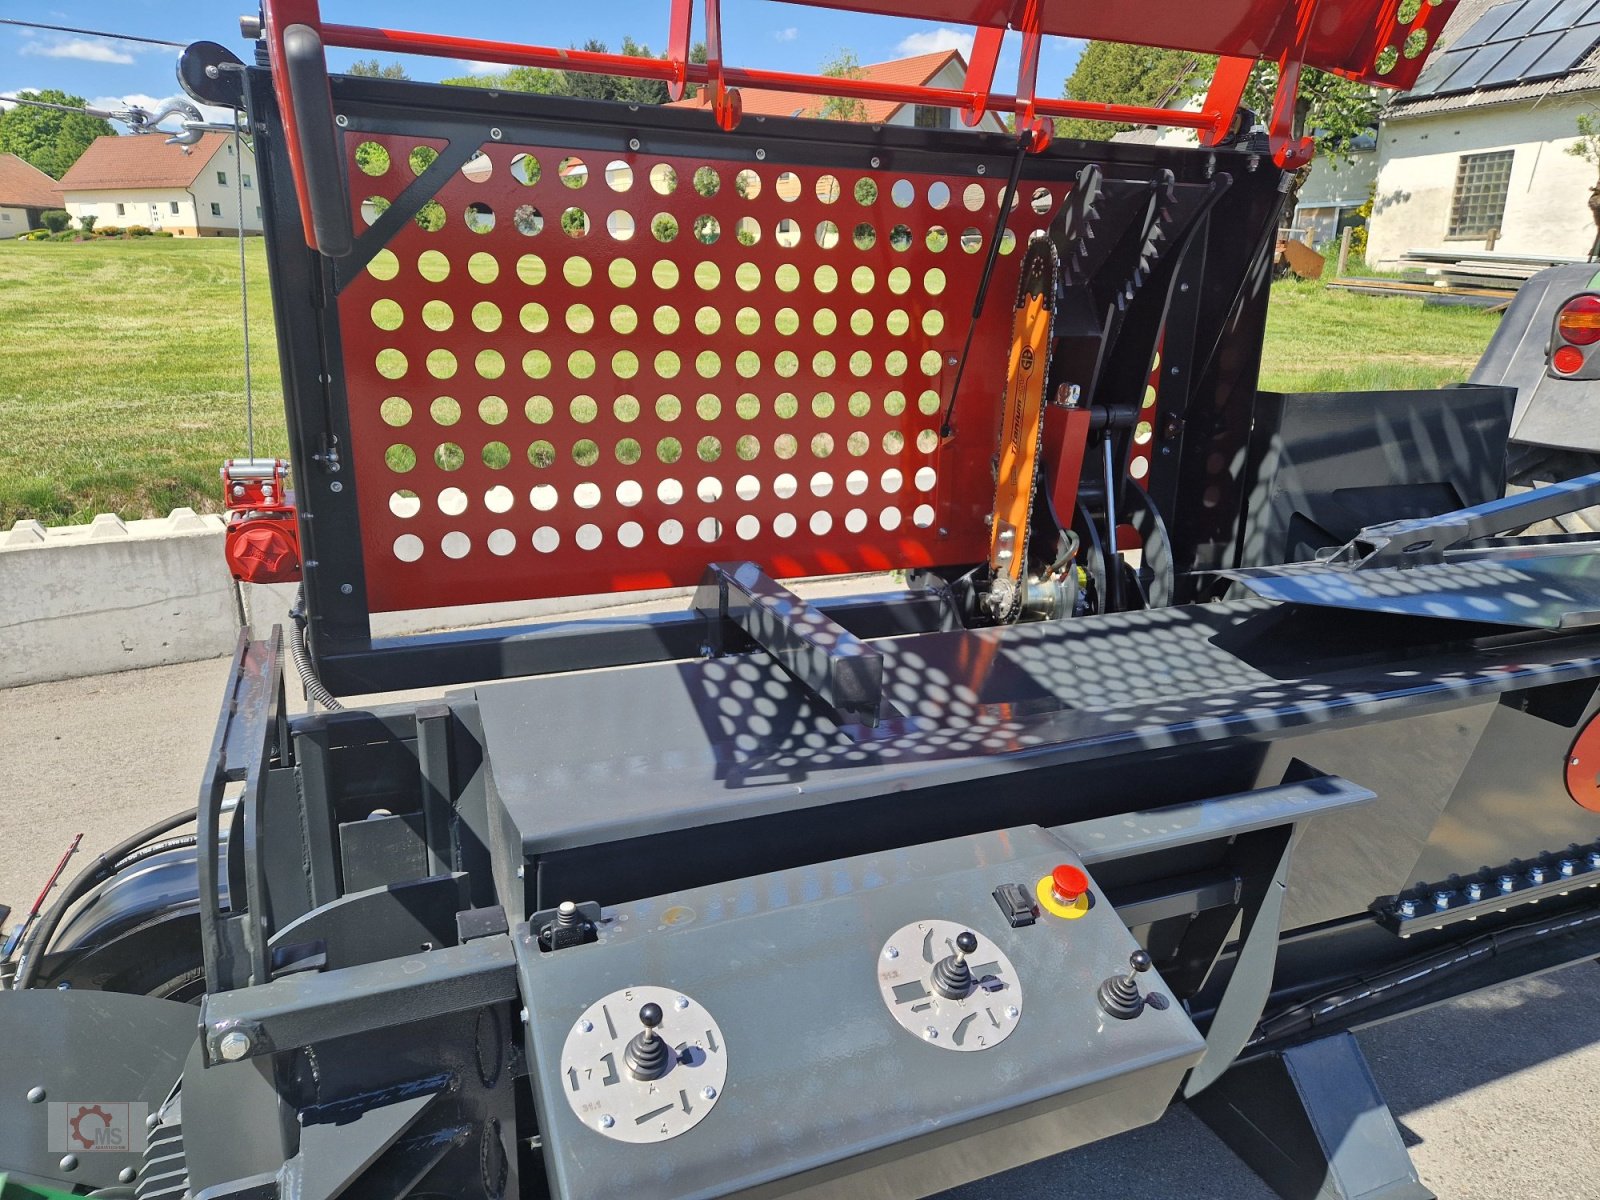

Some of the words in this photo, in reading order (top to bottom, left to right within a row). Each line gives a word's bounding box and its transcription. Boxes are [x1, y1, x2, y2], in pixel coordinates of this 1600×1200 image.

[1011, 398, 1023, 455] Titanium
[625, 991, 634, 1002] 5
[977, 1035, 986, 1046] 2
[584, 1068, 593, 1080] 7
[660, 1123, 668, 1135] 4
